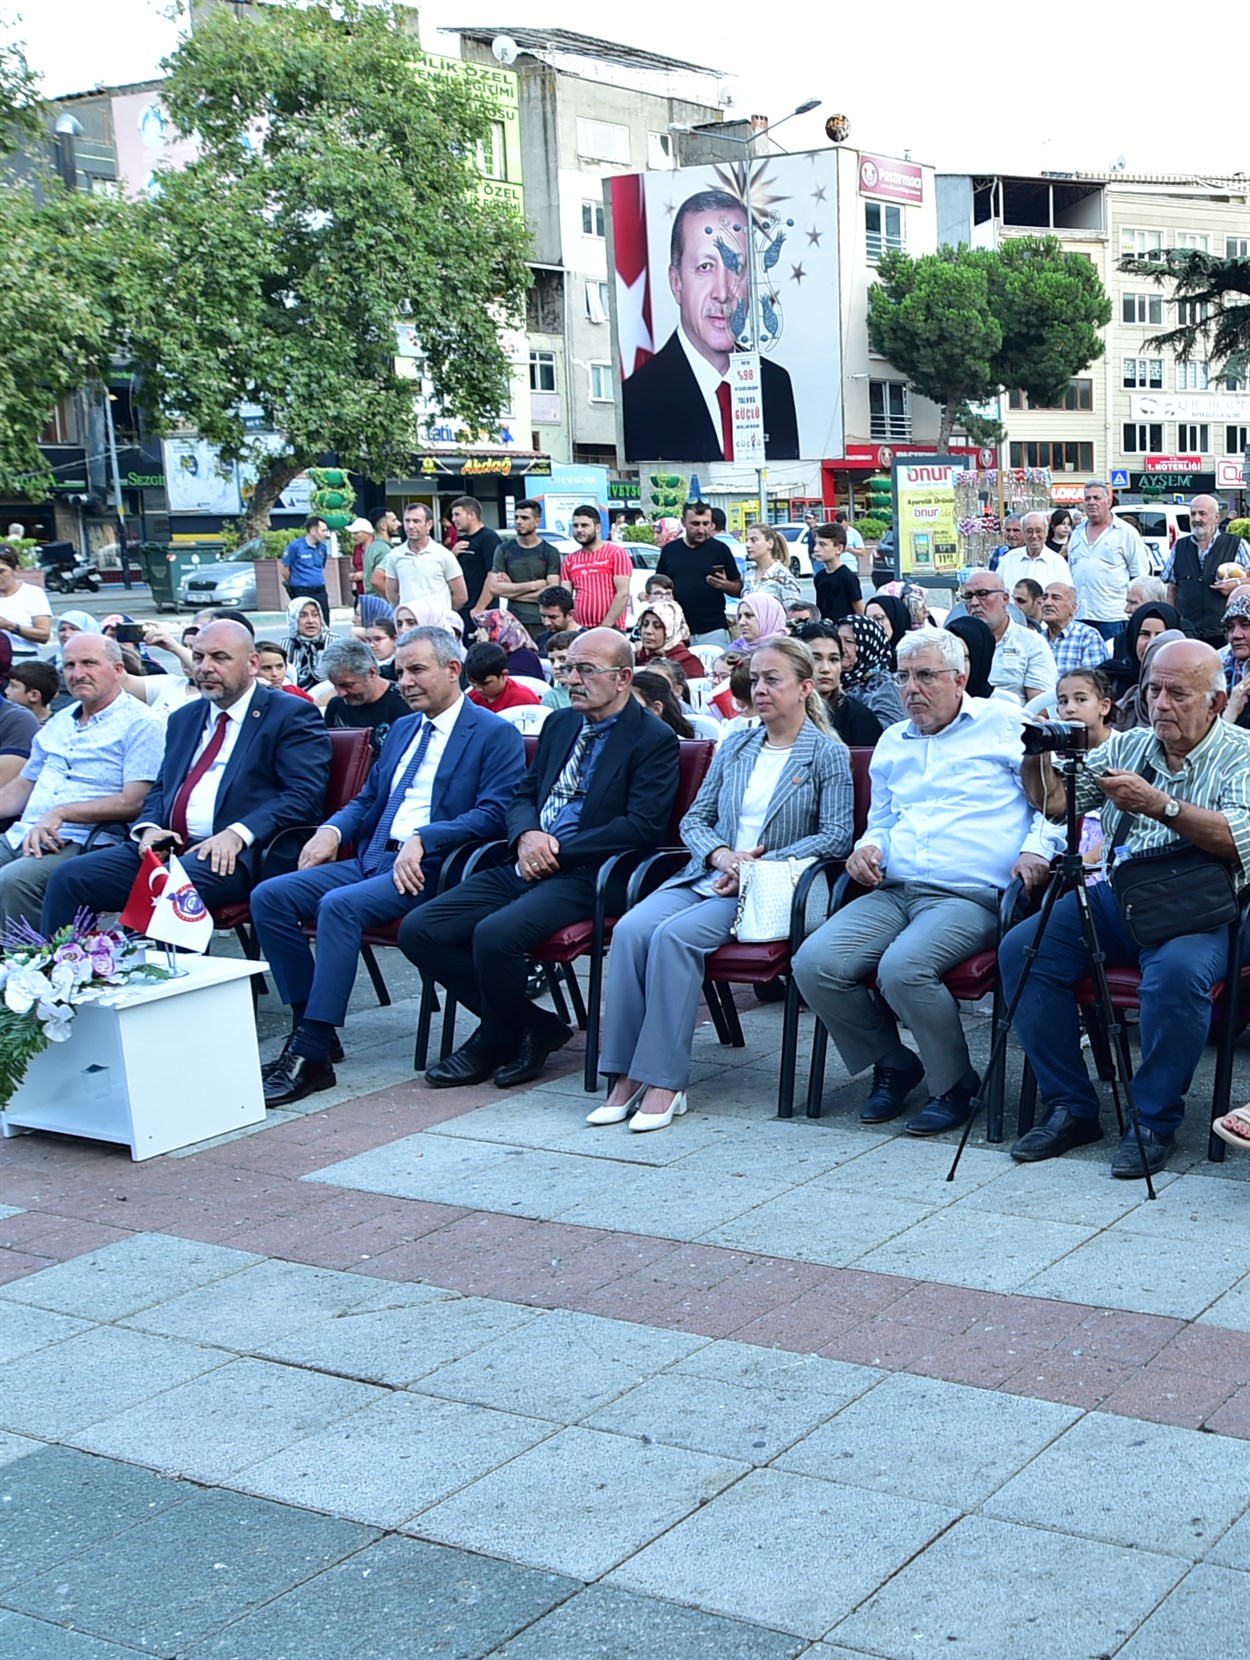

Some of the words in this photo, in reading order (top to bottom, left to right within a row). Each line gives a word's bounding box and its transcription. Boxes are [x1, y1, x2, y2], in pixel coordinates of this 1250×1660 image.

[464, 63, 514, 85] ÖZEL
[483, 181, 520, 200] ÖZEL
[1155, 461, 1201, 471] NOTERLİĞİ
[1138, 474, 1193, 489] AYŞEM
